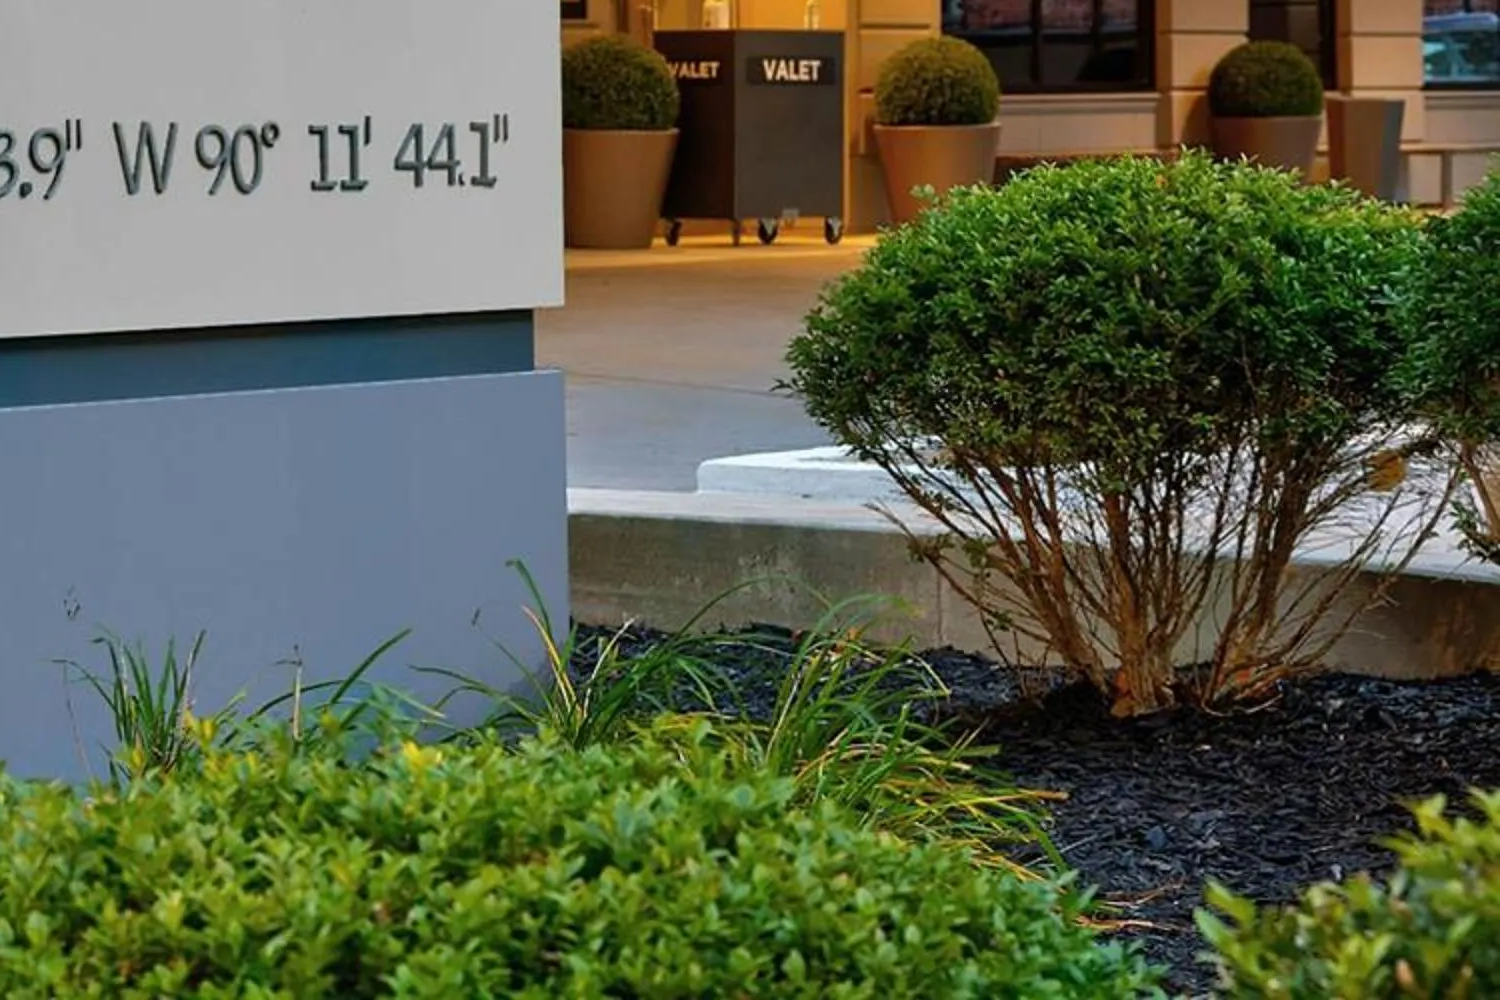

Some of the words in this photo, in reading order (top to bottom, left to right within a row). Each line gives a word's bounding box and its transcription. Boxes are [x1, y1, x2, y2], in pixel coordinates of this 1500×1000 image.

[668, 60, 721, 79] VALET
[762, 58, 822, 82] VALET
[111, 119, 179, 197] W
